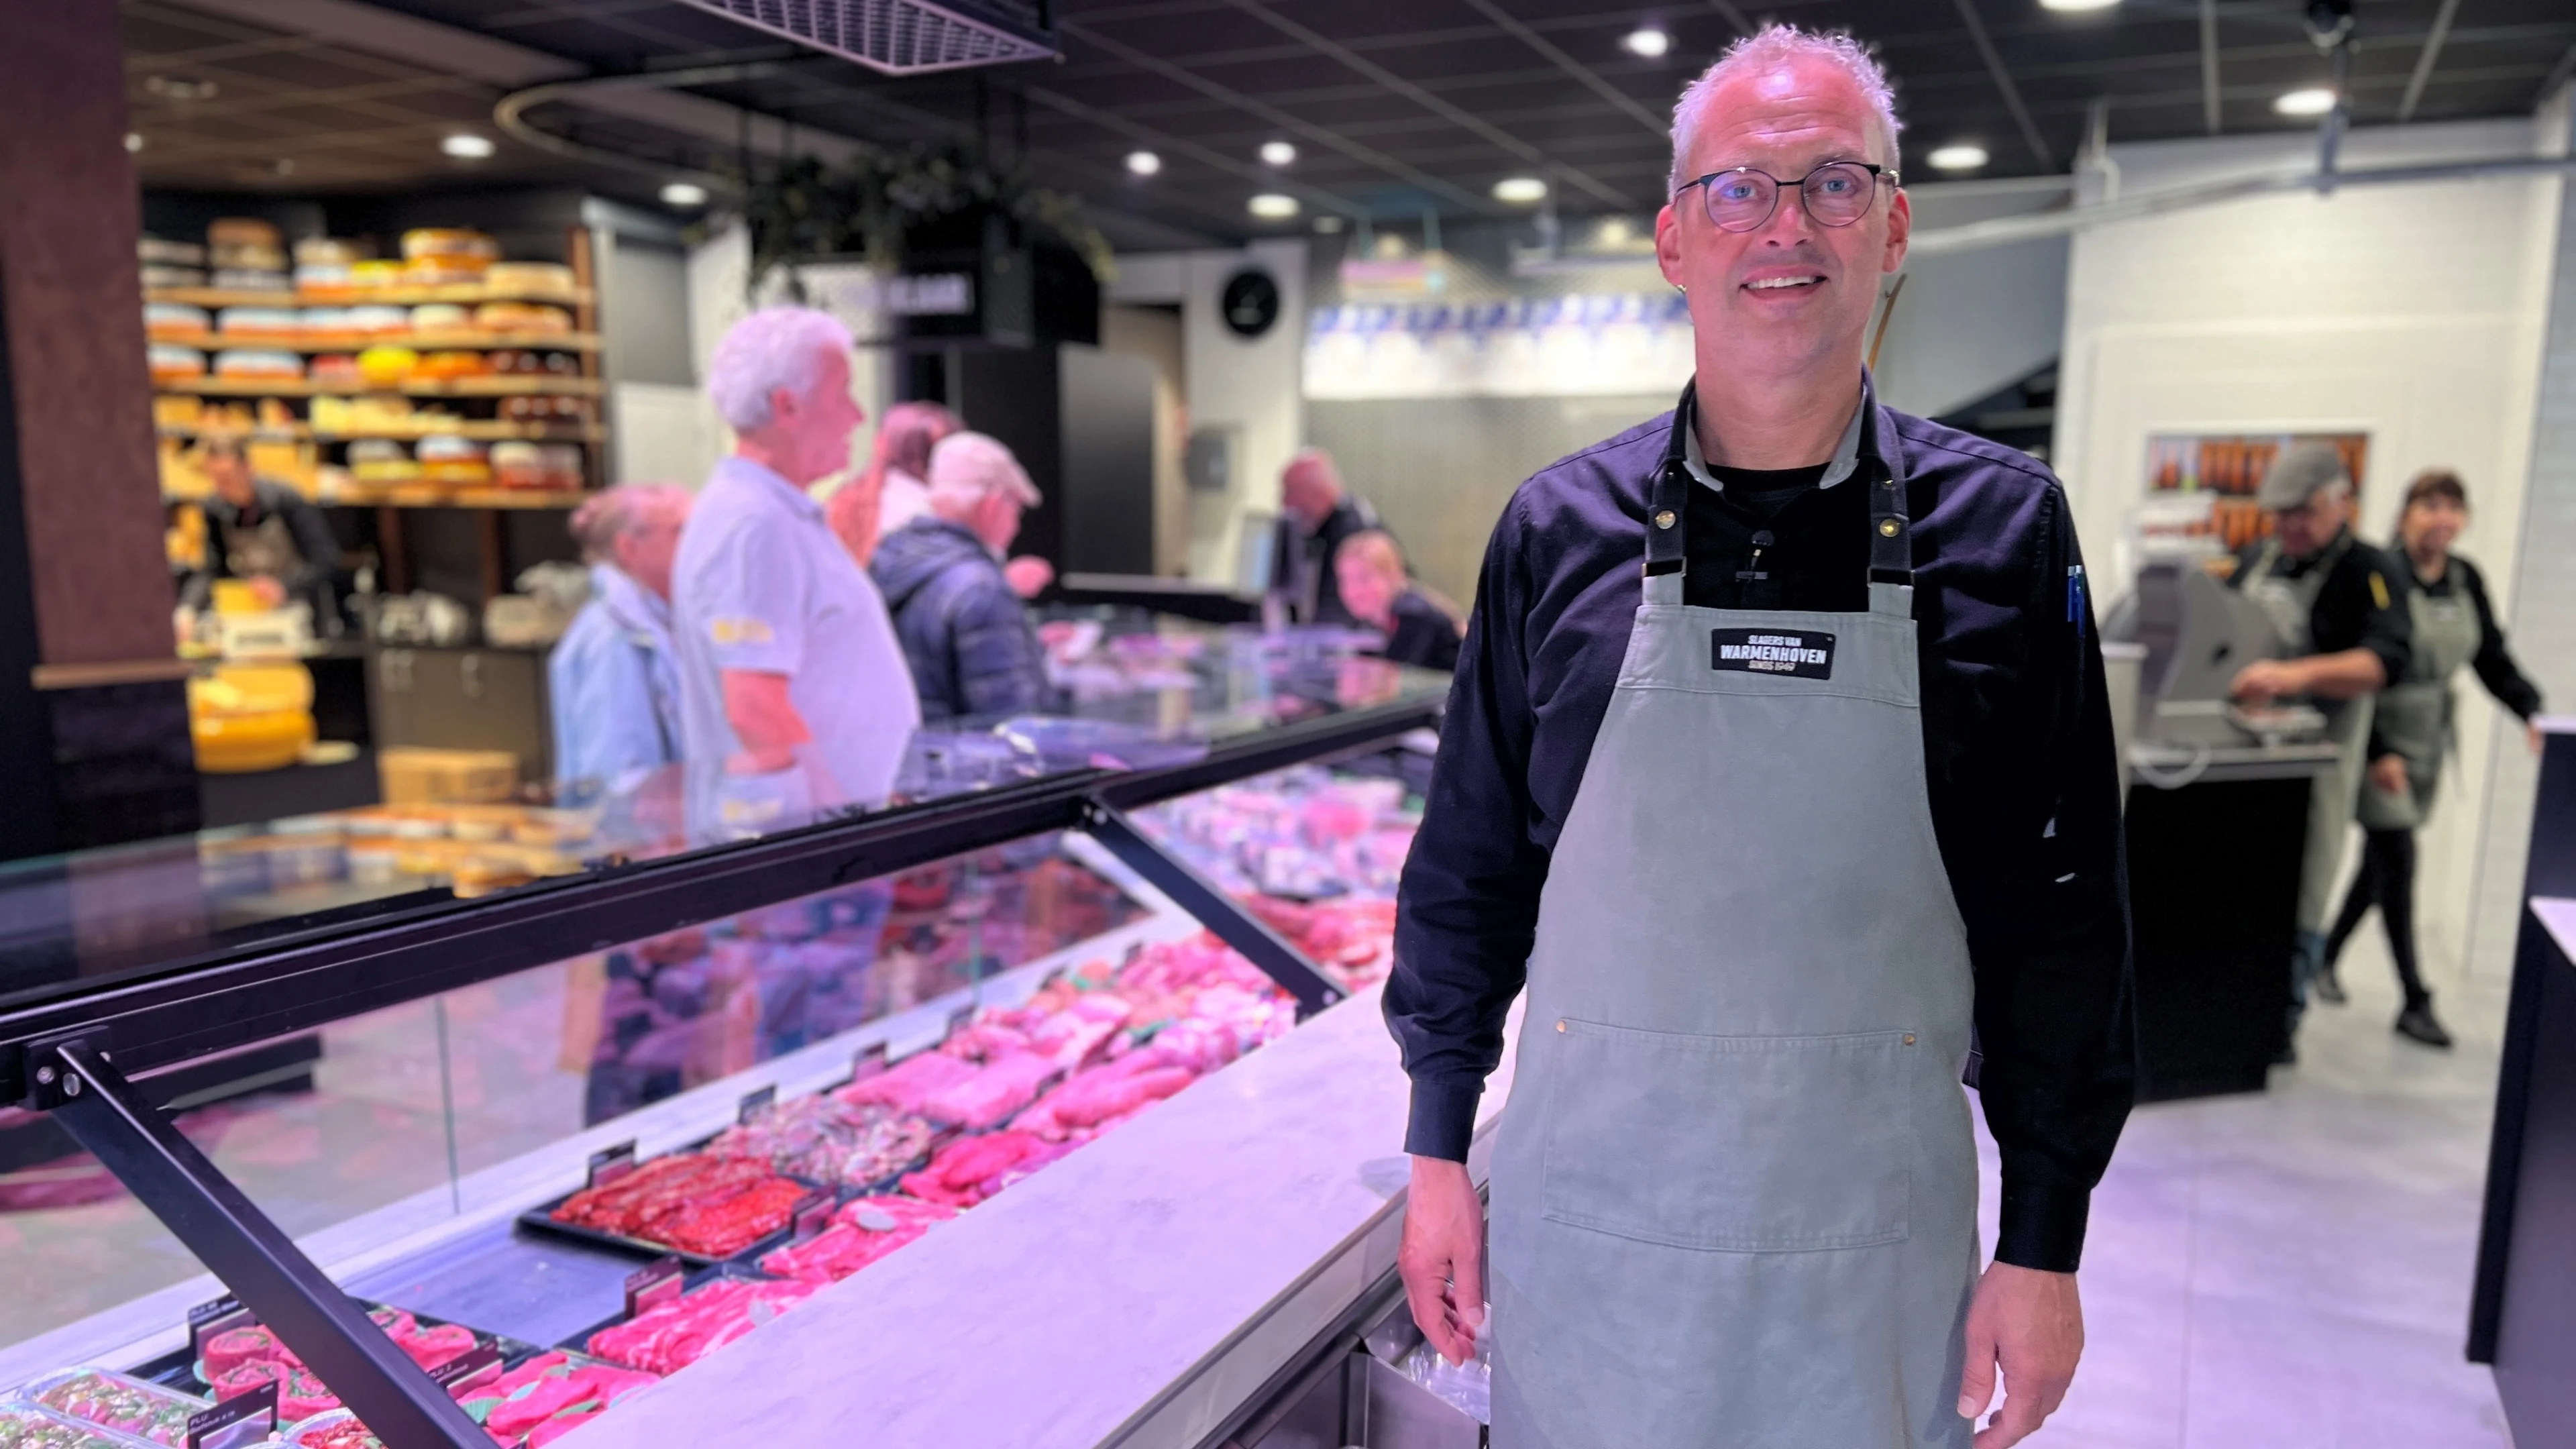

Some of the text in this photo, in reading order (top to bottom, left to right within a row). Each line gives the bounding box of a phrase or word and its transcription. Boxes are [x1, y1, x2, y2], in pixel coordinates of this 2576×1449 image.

[1748, 635, 1802, 647] SLAGERS VAN
[1721, 645, 1827, 664] WARMENHOVEN
